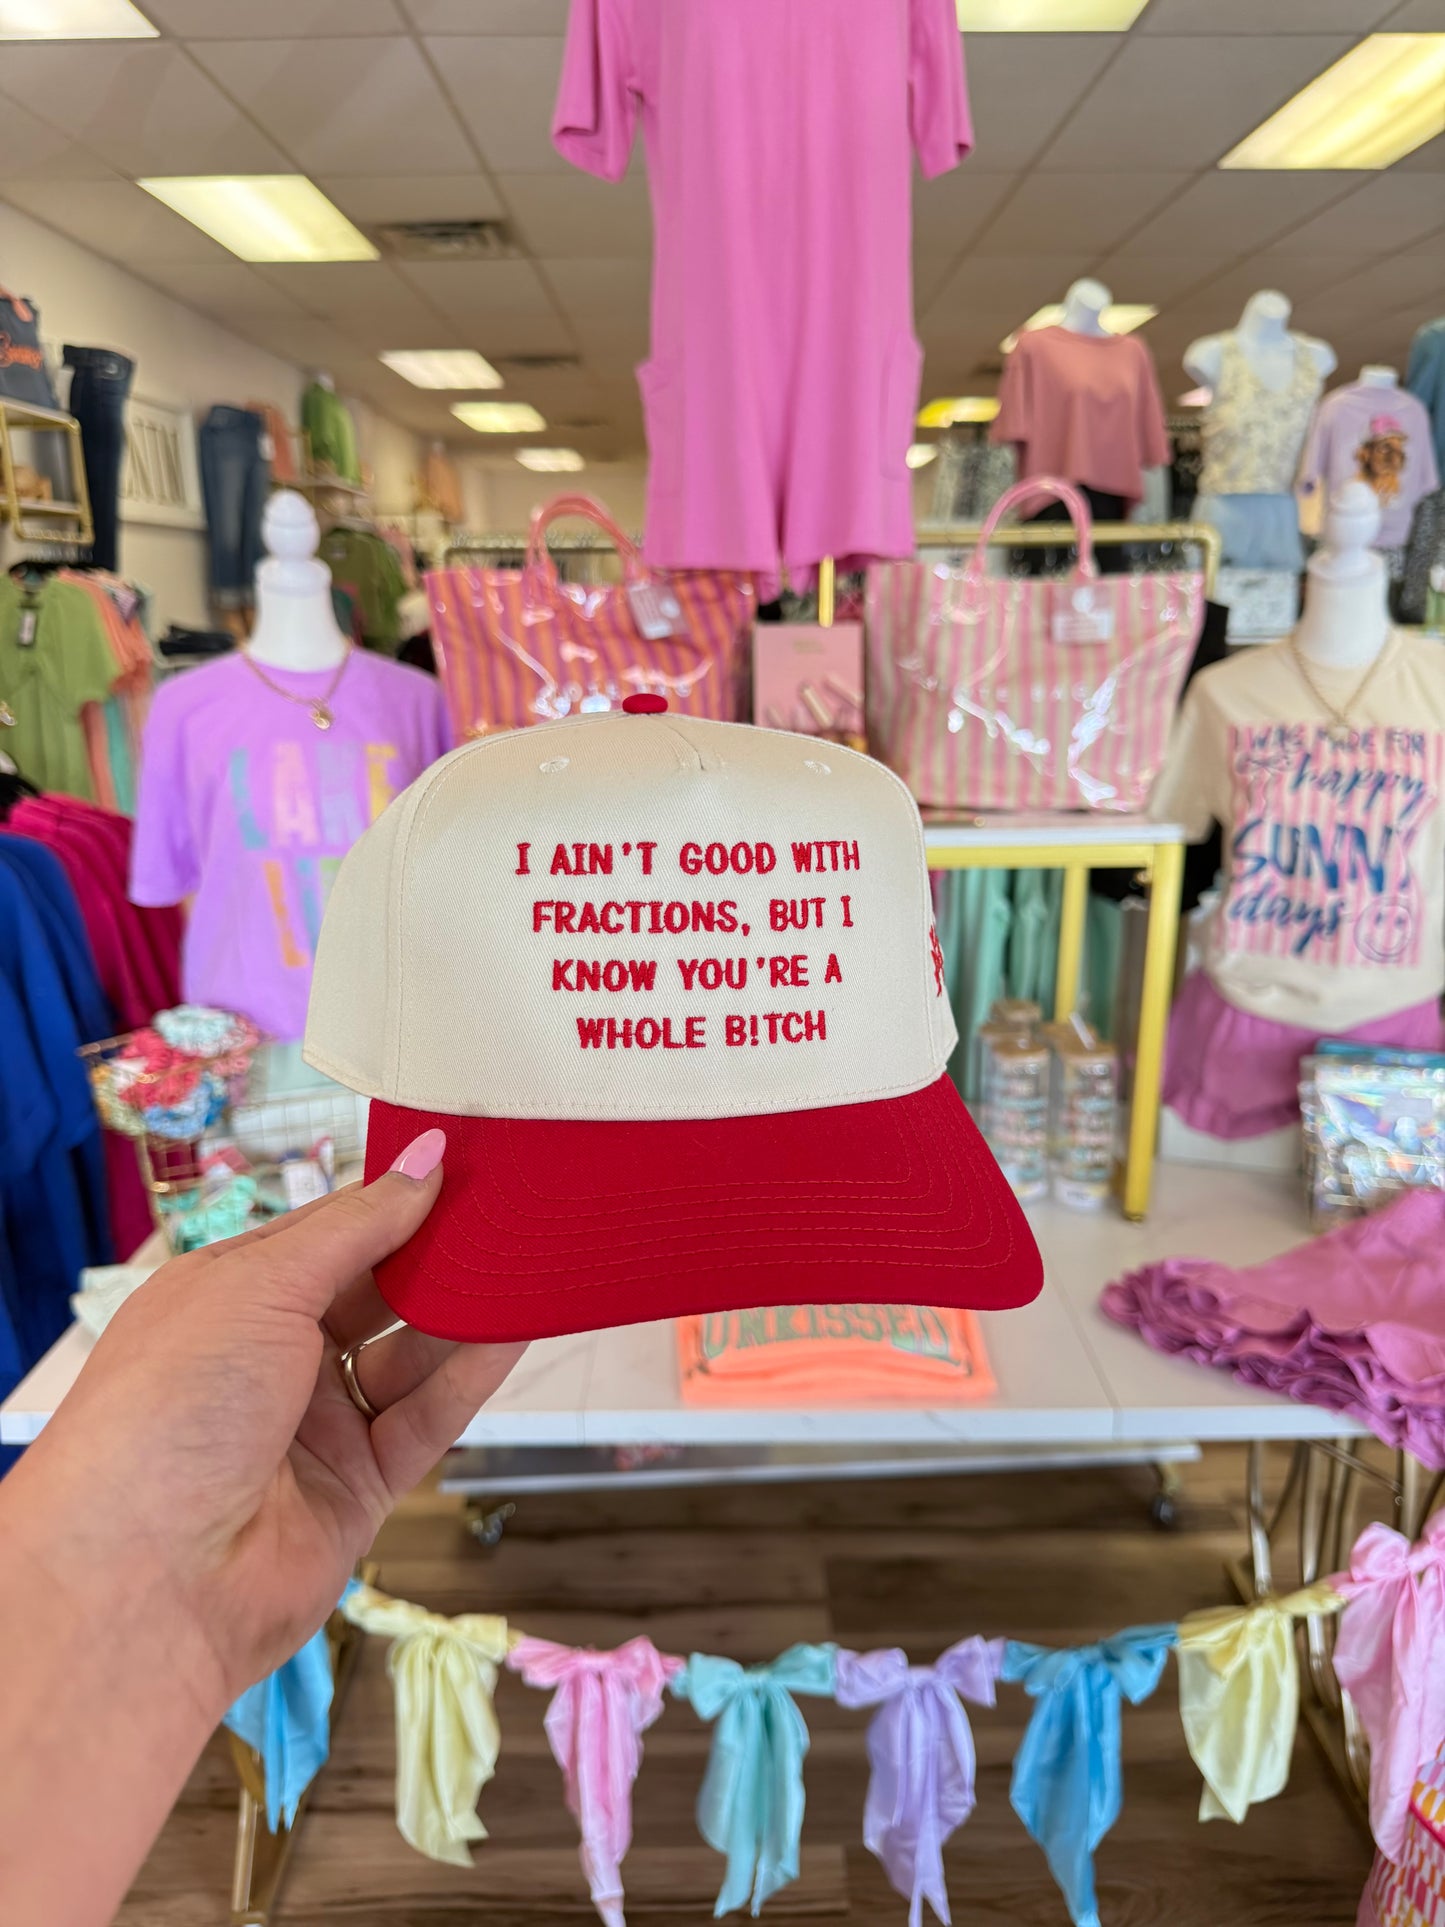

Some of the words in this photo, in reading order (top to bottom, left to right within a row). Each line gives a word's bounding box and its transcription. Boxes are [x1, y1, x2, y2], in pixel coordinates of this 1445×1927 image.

[516, 843, 531, 875] I
[550, 842, 657, 876] AIN'T
[679, 842, 776, 875] GOOD
[791, 840, 860, 873] WITH
[533, 900, 750, 937] FRACTIONS,
[769, 897, 826, 932] BUT
[840, 895, 853, 927] I
[552, 959, 657, 992] KNOW
[677, 955, 809, 991] YOU'RE
[824, 953, 842, 984] A
[576, 1017, 706, 1050] WHOLE
[725, 1010, 826, 1047] B!TCH
